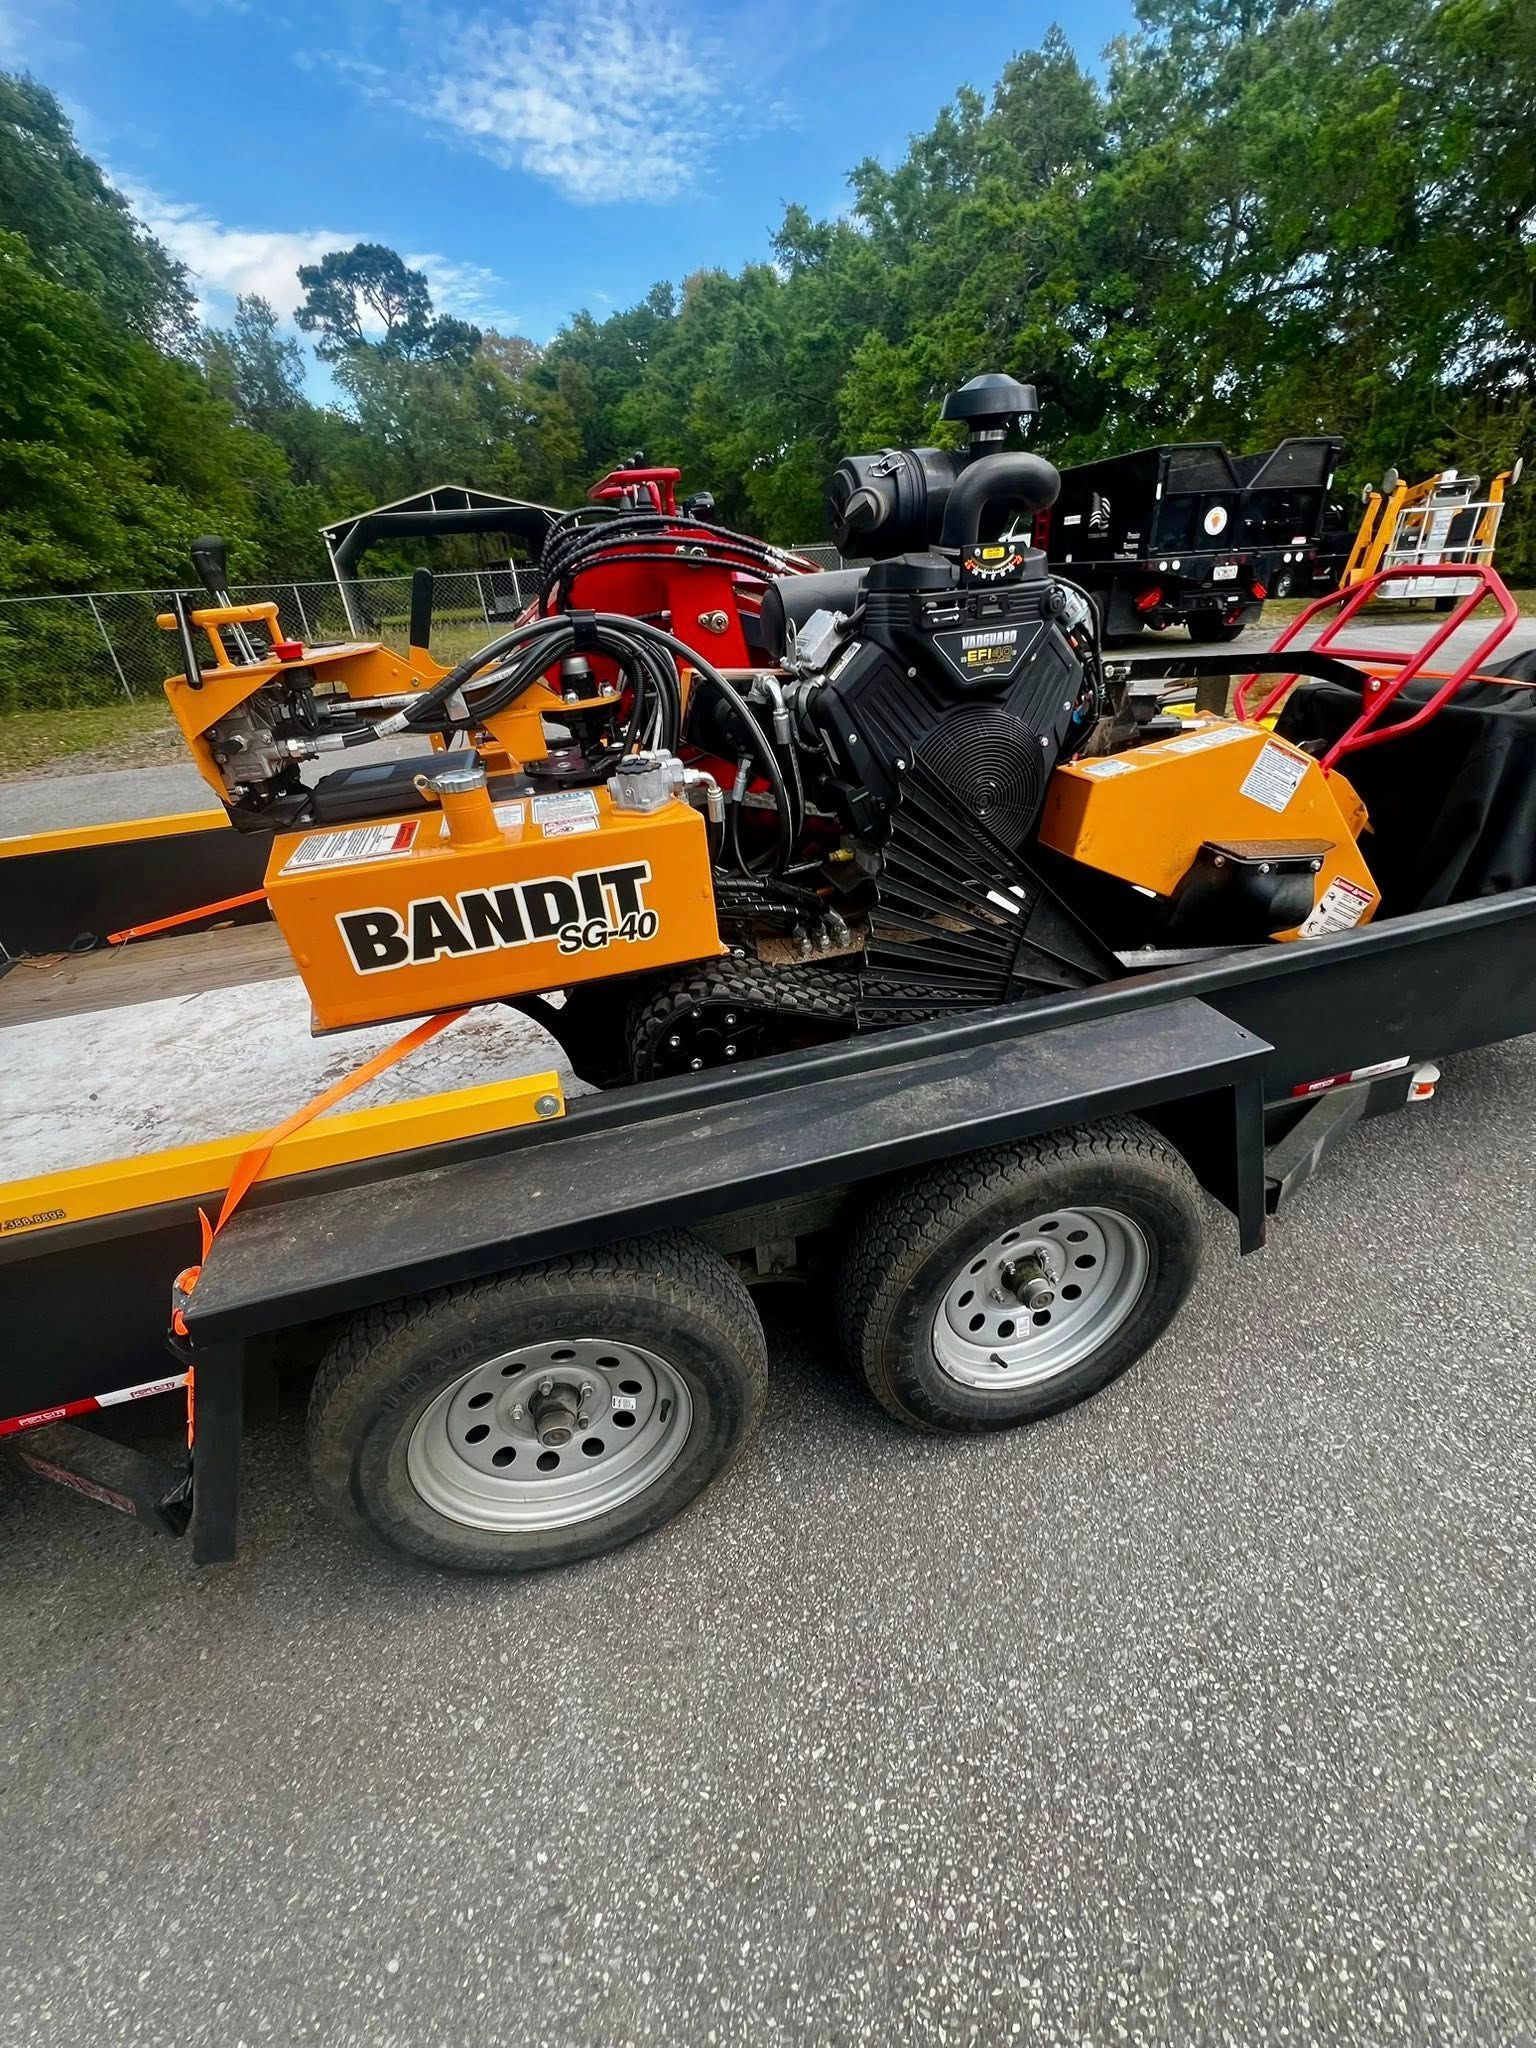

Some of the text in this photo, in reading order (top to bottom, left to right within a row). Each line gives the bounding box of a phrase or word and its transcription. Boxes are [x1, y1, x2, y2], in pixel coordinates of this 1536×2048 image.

[961, 630, 1017, 650] VANGUARD
[340, 865, 648, 971] BANDIT
[558, 911, 658, 954] SG-40
